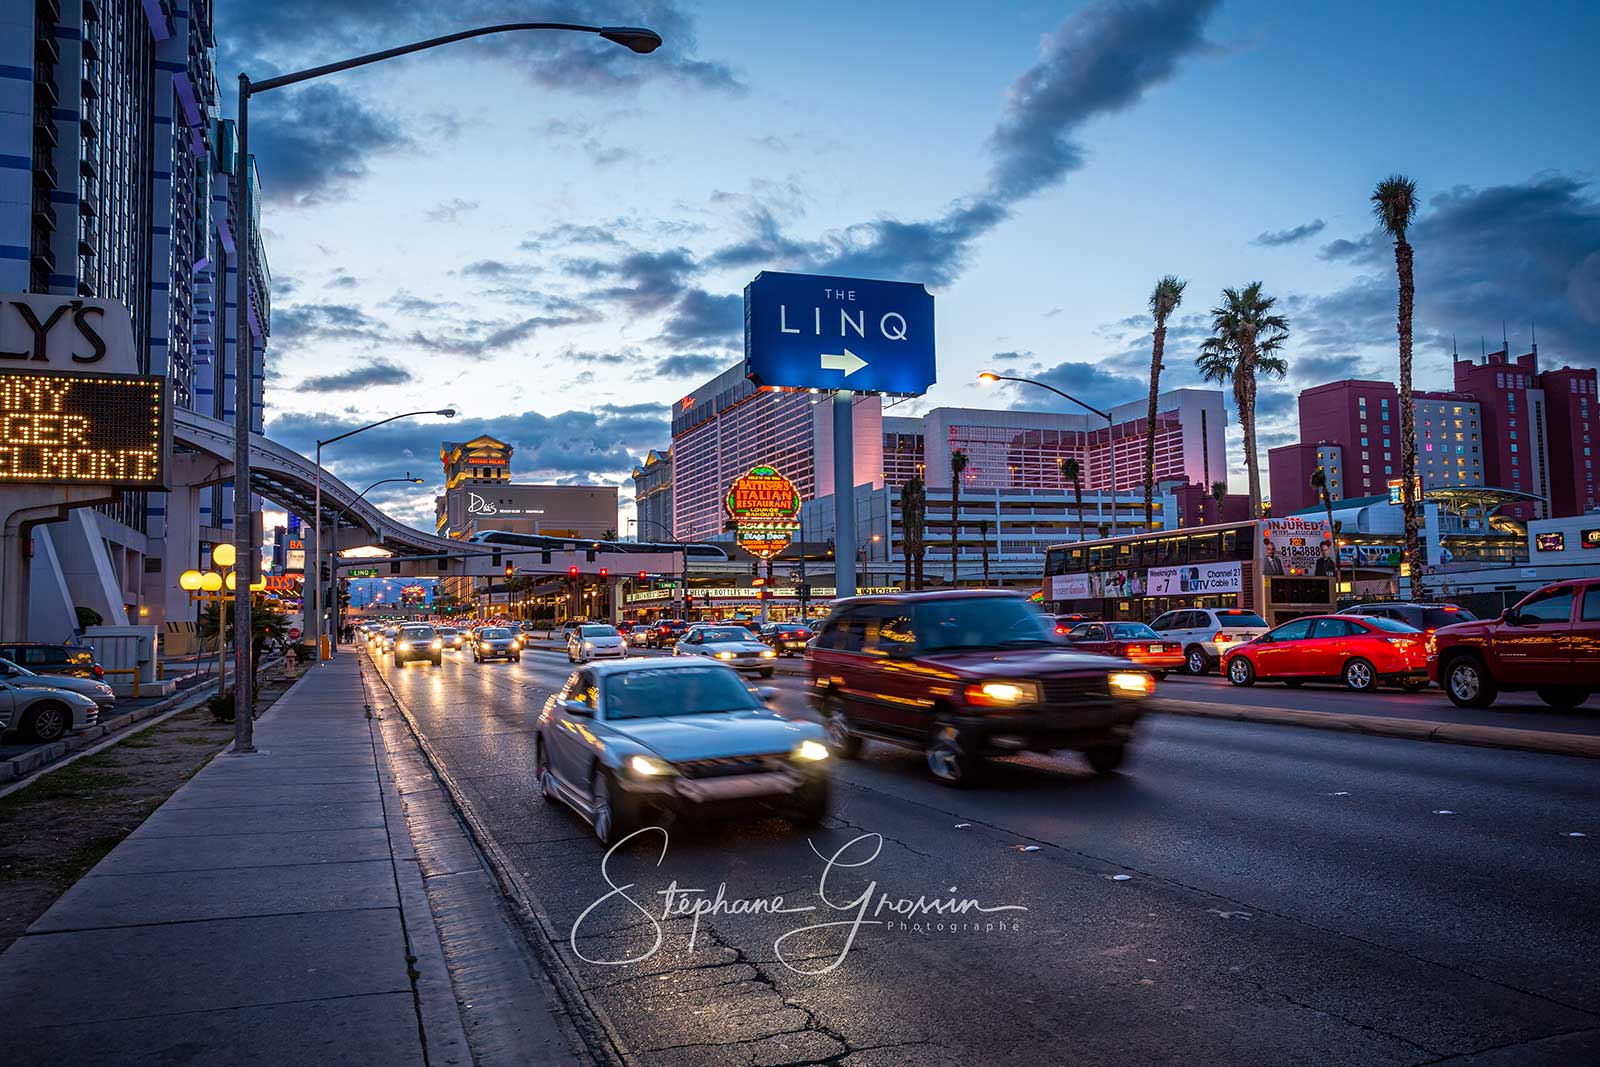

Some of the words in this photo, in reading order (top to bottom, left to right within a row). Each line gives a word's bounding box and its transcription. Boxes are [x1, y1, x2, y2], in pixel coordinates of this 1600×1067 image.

[825, 288, 856, 301] THE
[780, 304, 908, 341] LINQ
[3, 412, 90, 446] GER
[736, 490, 792, 501] ITALIAN
[736, 500, 792, 509] RESTAURANT
[1268, 521, 1324, 531] INJURED?
[1207, 569, 1232, 578] Channel
[1233, 568, 1240, 576] 21
[1164, 579, 1169, 593] 7
[1210, 579, 1230, 587] Cable
[1231, 578, 1239, 587] 12
[714, 588, 741, 596] BOTTLES
